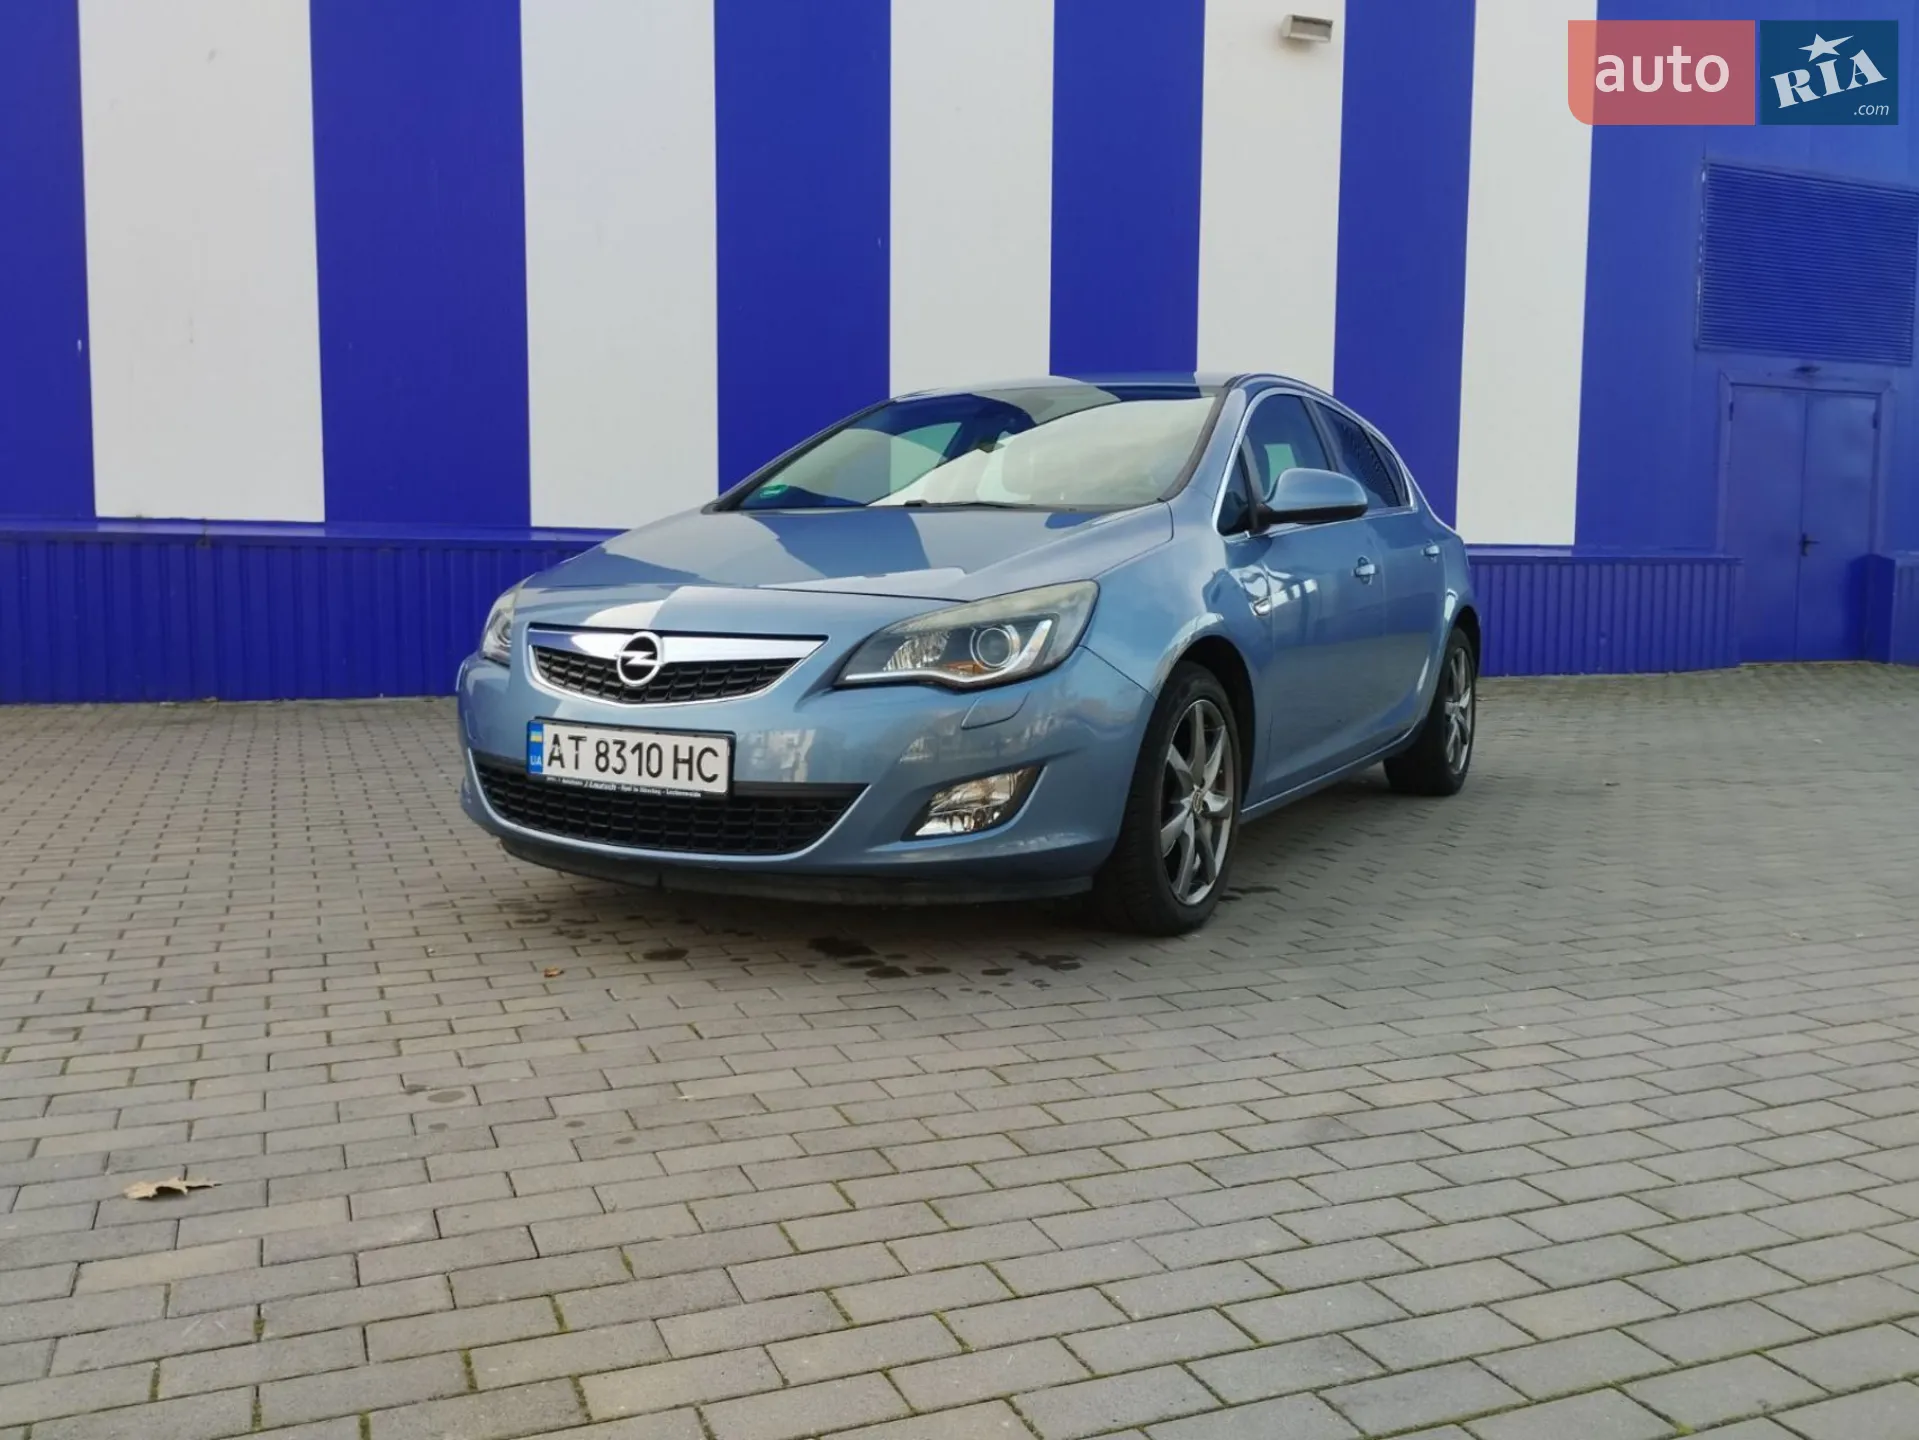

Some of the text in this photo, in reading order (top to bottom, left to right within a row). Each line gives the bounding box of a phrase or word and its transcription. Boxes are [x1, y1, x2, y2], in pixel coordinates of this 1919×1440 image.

[530, 756, 543, 766] UA
[547, 733, 719, 784] AT 8310 HC
